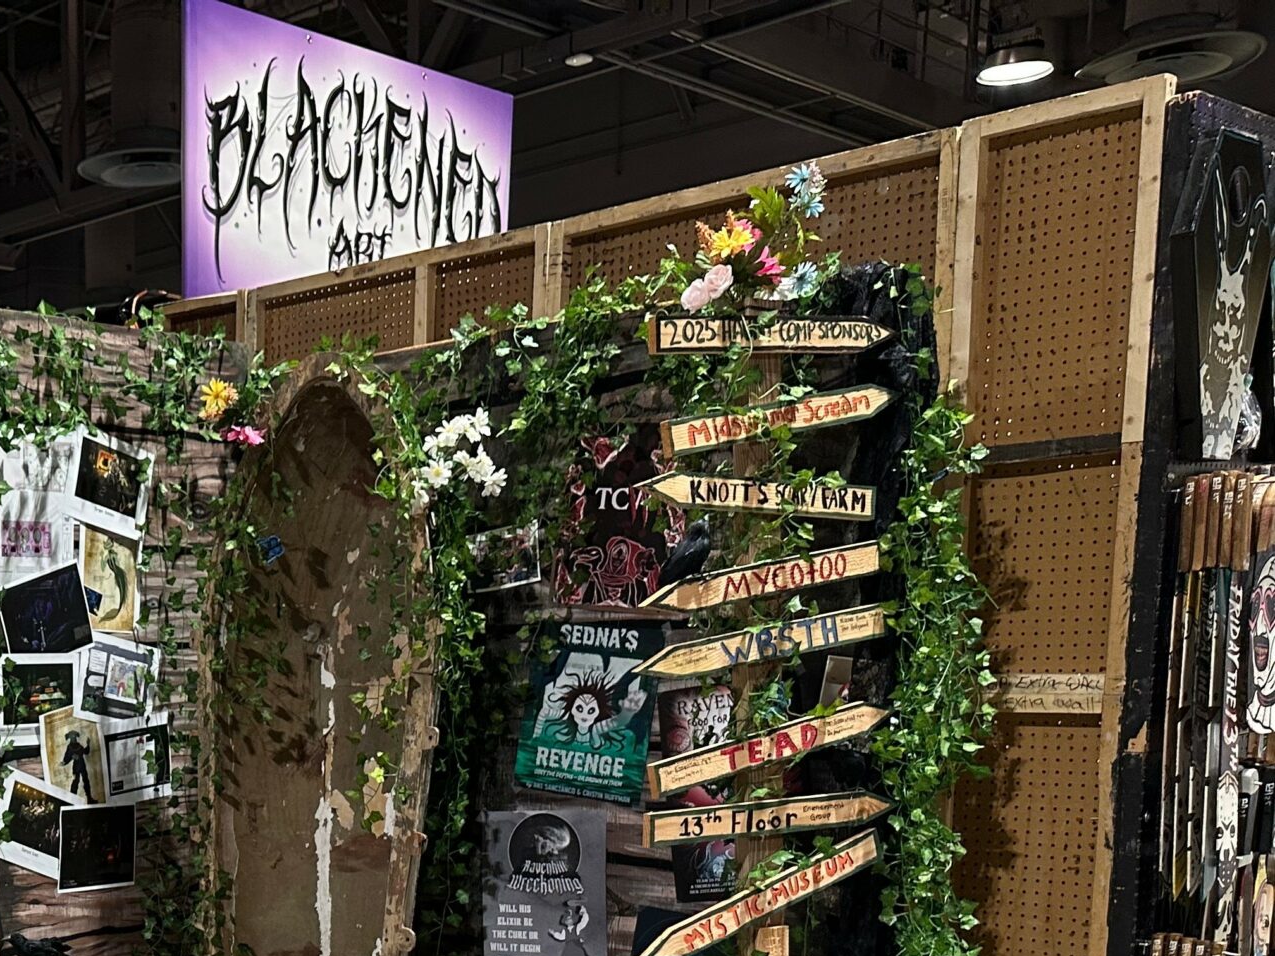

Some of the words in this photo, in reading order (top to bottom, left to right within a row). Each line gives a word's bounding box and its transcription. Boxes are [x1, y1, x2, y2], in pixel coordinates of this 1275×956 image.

[328, 216, 393, 272] ART
[664, 320, 717, 346] 2025
[778, 320, 815, 343] COMP
[817, 321, 883, 345] SPONSORS
[802, 393, 871, 424] Scream
[689, 479, 768, 505] KNOTT'S
[820, 487, 867, 514] FARM
[560, 624, 639, 652] SEDNA'S
[1226, 584, 1243, 670] FRIDAY
[1226, 670, 1238, 709] THE
[535, 746, 626, 778] REVENGE
[679, 812, 722, 837] 13th
[732, 808, 798, 834] Floor
[499, 903, 517, 913] WILL
[519, 904, 531, 913] HIS
[683, 892, 765, 951] MYSTIC
[771, 851, 855, 904] MUSEUM
[492, 930, 506, 939] THE
[508, 930, 527, 939] CURE
[529, 931, 539, 940] OR
[497, 917, 521, 926] ELIXIR
[523, 918, 533, 926] BE
[490, 942, 508, 951] WILL
[510, 943, 517, 952] IT
[520, 943, 541, 953] BEGIN
